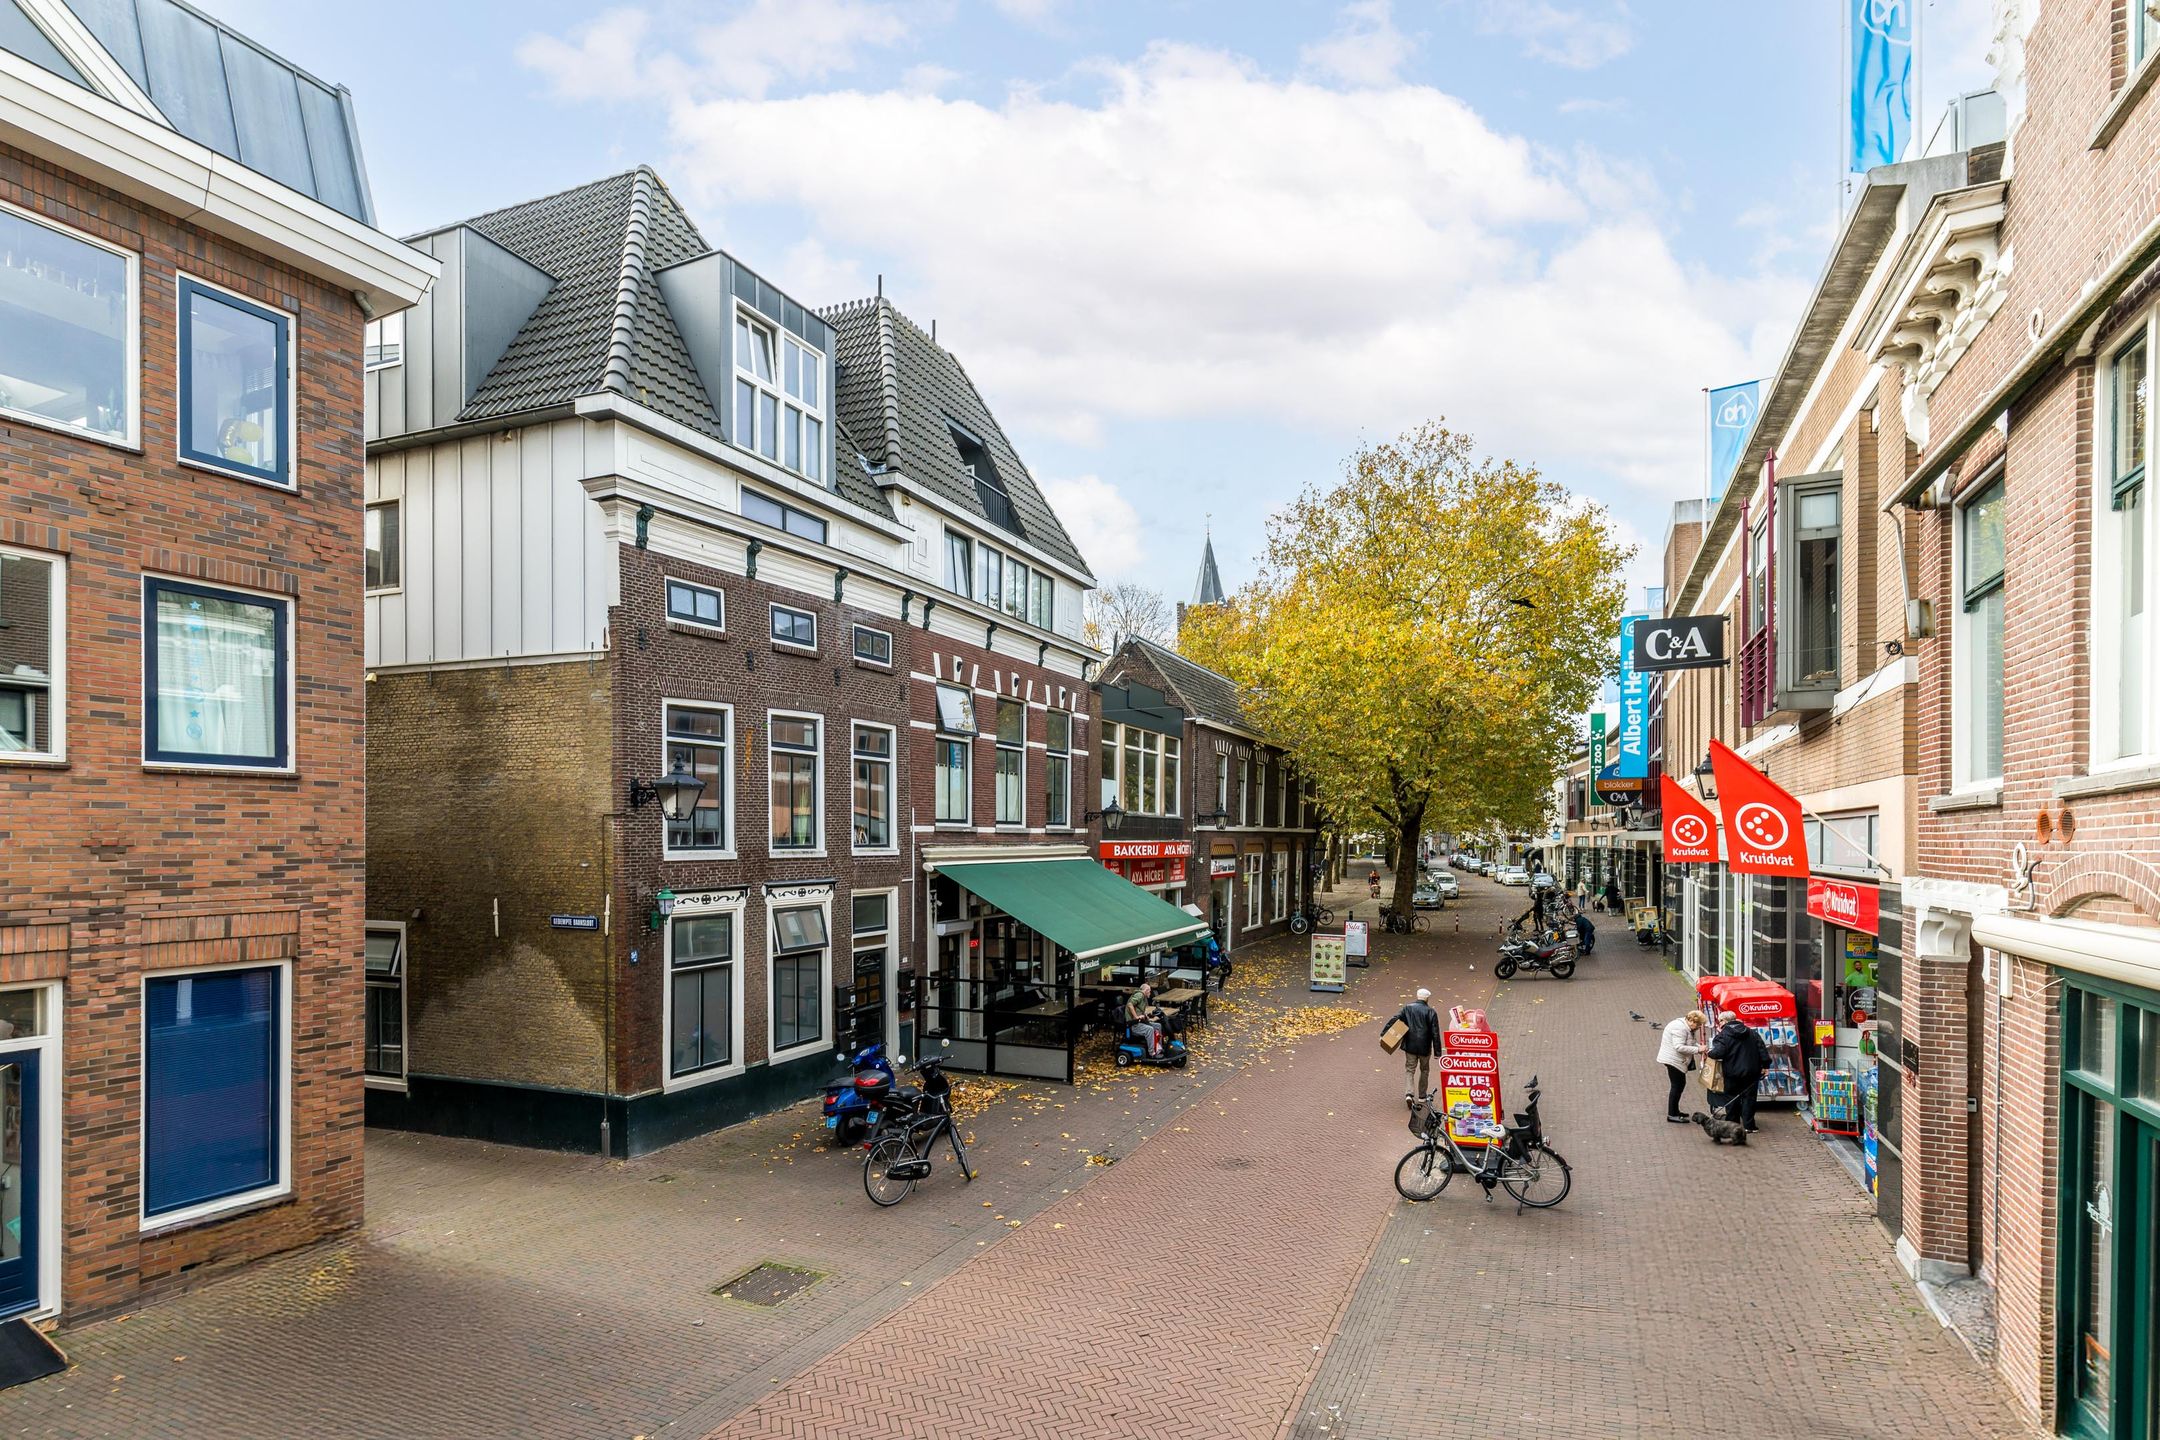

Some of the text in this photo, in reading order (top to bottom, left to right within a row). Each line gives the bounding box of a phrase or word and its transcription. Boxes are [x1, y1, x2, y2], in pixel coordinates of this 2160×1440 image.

[1645, 626, 1711, 660] C&A
[1623, 697, 1641, 756] Albert
[1594, 744, 1603, 763] zoo
[1609, 792, 1629, 802] C&A
[1164, 844, 1176, 856] AYA
[1672, 848, 1709, 856] Kruidvat
[1740, 851, 1795, 866] Kruidvat
[1131, 872, 1143, 883] AYA
[1831, 890, 1856, 916] Kruidvat
[1080, 957, 1100, 971] Heineken
[1460, 1036, 1489, 1045] Kruidvat
[1453, 1059, 1492, 1069] Kruidvat
[1447, 1074, 1490, 1087] ACTIE!
[1470, 1089, 1492, 1098] 60%
